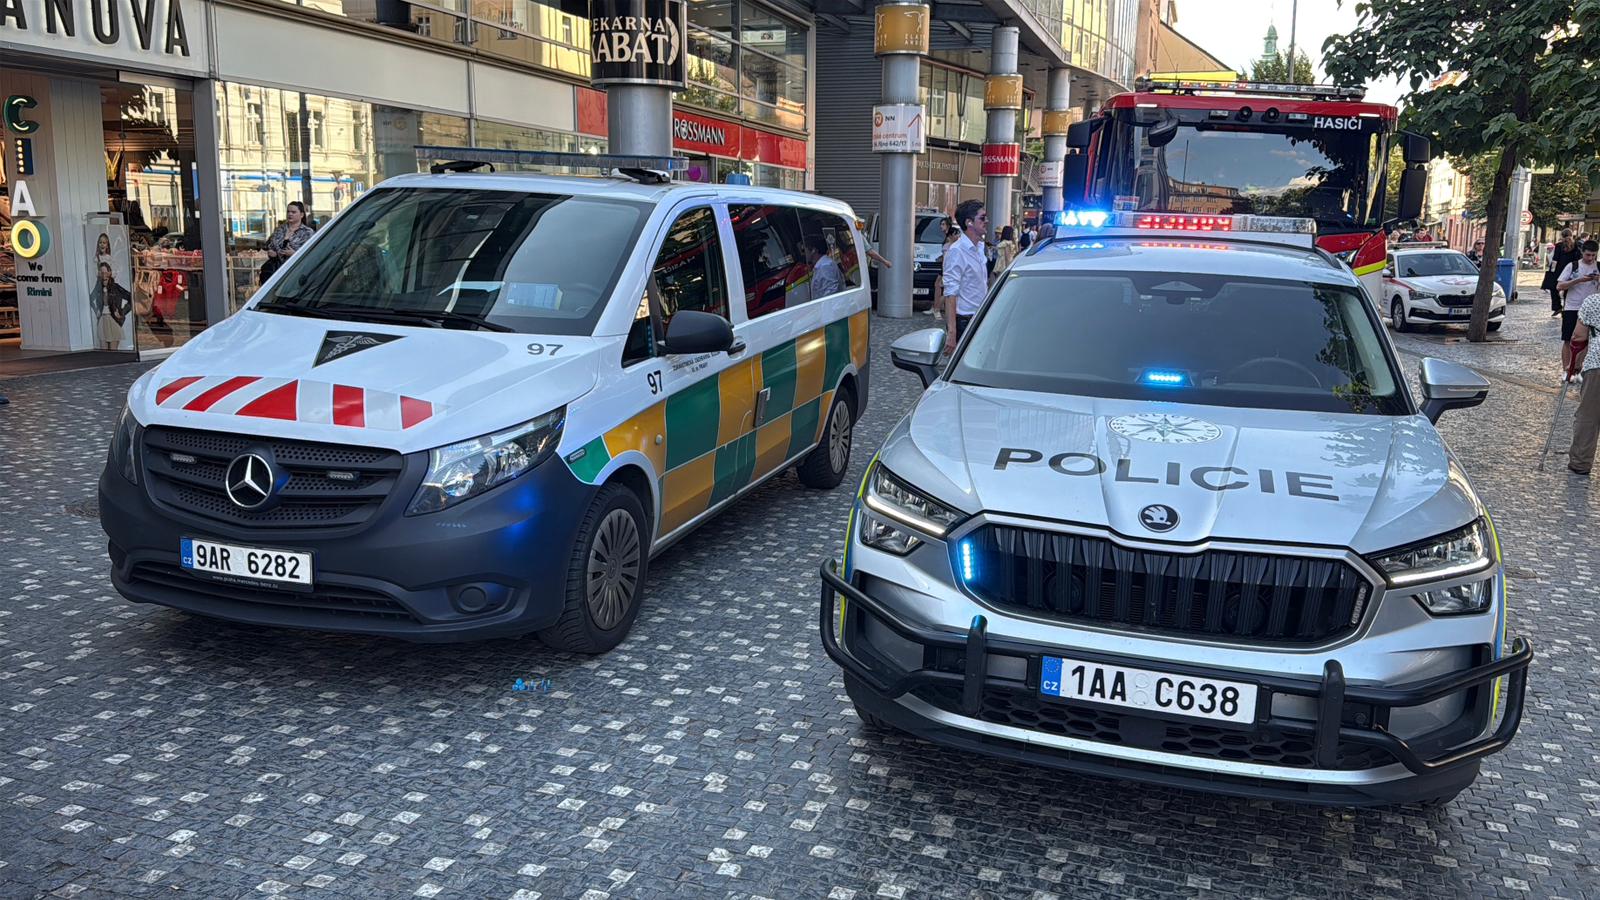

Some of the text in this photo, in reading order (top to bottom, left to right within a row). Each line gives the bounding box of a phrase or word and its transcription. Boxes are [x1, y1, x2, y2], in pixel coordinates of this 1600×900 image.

[591, 16, 665, 32] EKÁRNA
[1313, 116, 1362, 130] HASIČI
[674, 118, 725, 146] ROSSMANN
[28, 262, 43, 271] We
[41, 273, 62, 283] from
[27, 287, 52, 296] Rimini
[527, 343, 563, 356] 97
[647, 370, 663, 395] 97
[993, 447, 1340, 502] POLICIE
[197, 544, 231, 572] 9AR
[247, 552, 300, 579] 6282
[1043, 665, 1240, 717] CZ 1AA C638
